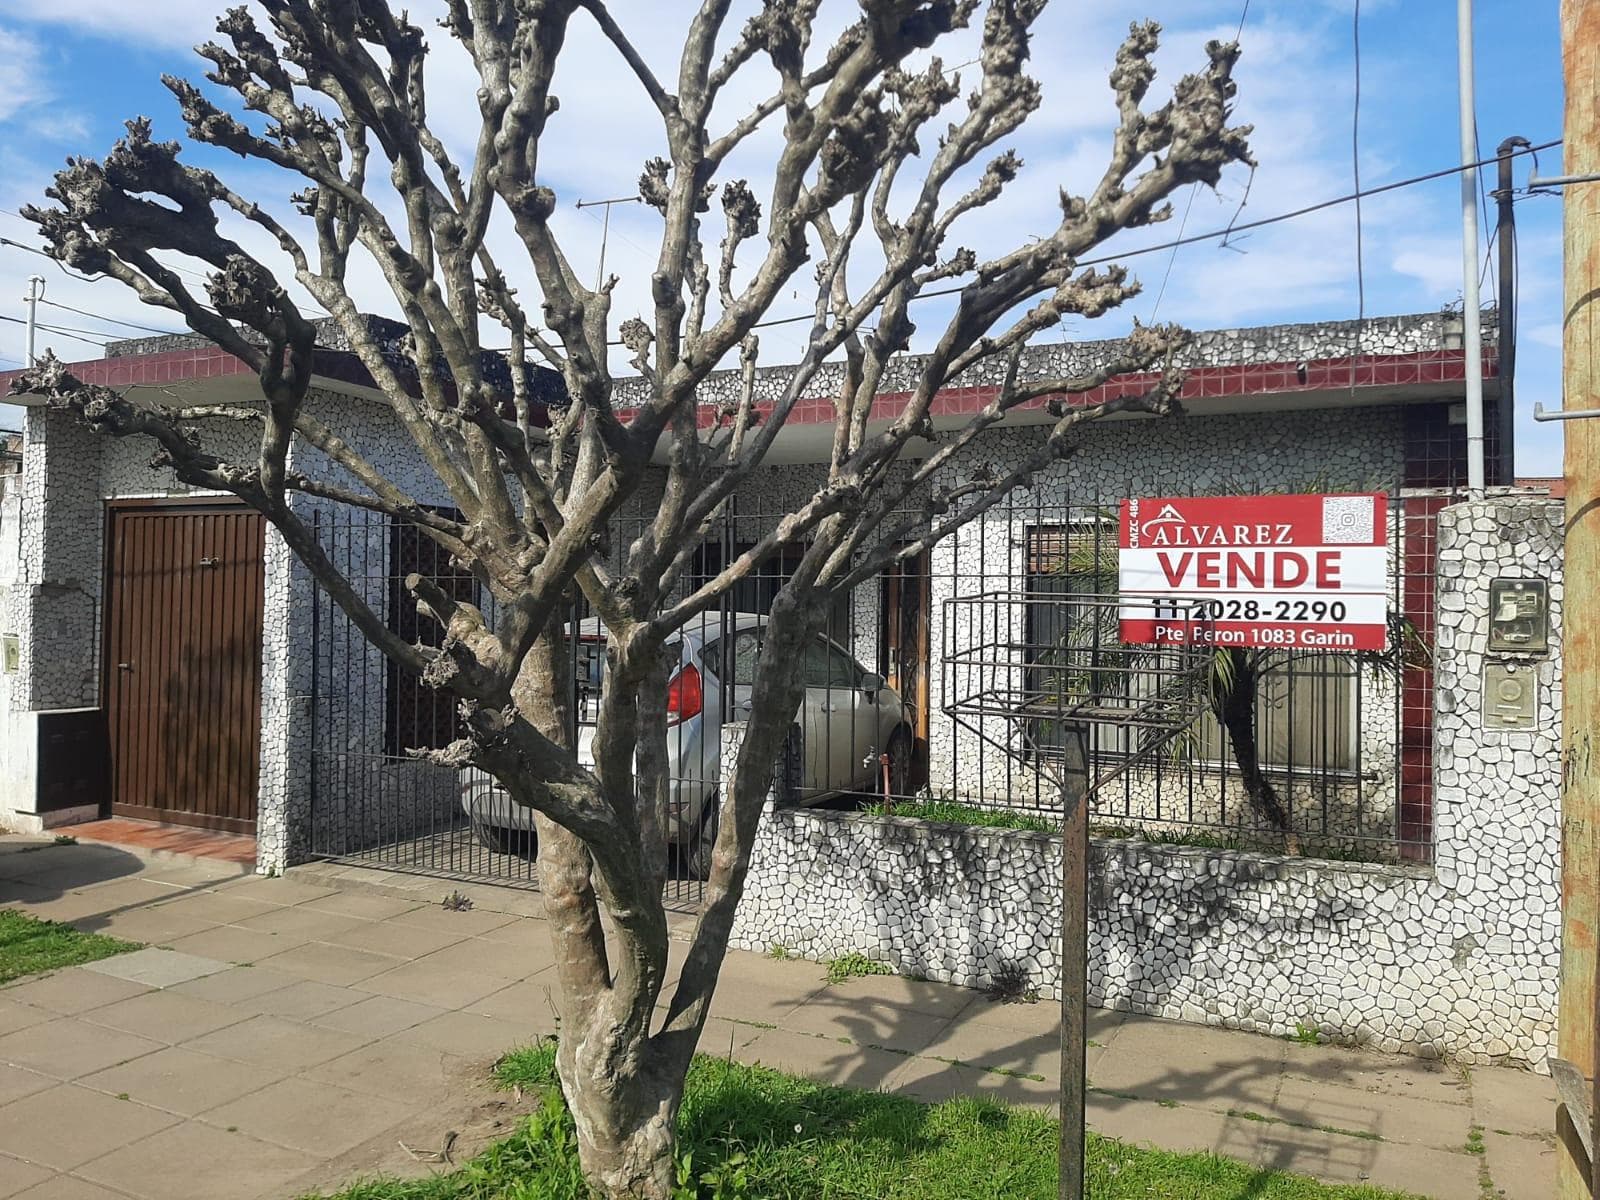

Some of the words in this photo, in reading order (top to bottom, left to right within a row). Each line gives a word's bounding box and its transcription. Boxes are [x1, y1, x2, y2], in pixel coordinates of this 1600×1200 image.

[1129, 499, 1139, 518] 486
[1129, 520, 1139, 549] CMZC
[1152, 525, 1293, 546] ALVAREZ
[1156, 551, 1342, 589] VENDE
[1151, 598, 1178, 619] 11
[1191, 599, 1348, 622] 2028-2290
[1155, 626, 1184, 641] Pte
[1193, 626, 1245, 642] Peron
[1251, 628, 1295, 644] 1083
[1301, 628, 1354, 646] Garin
